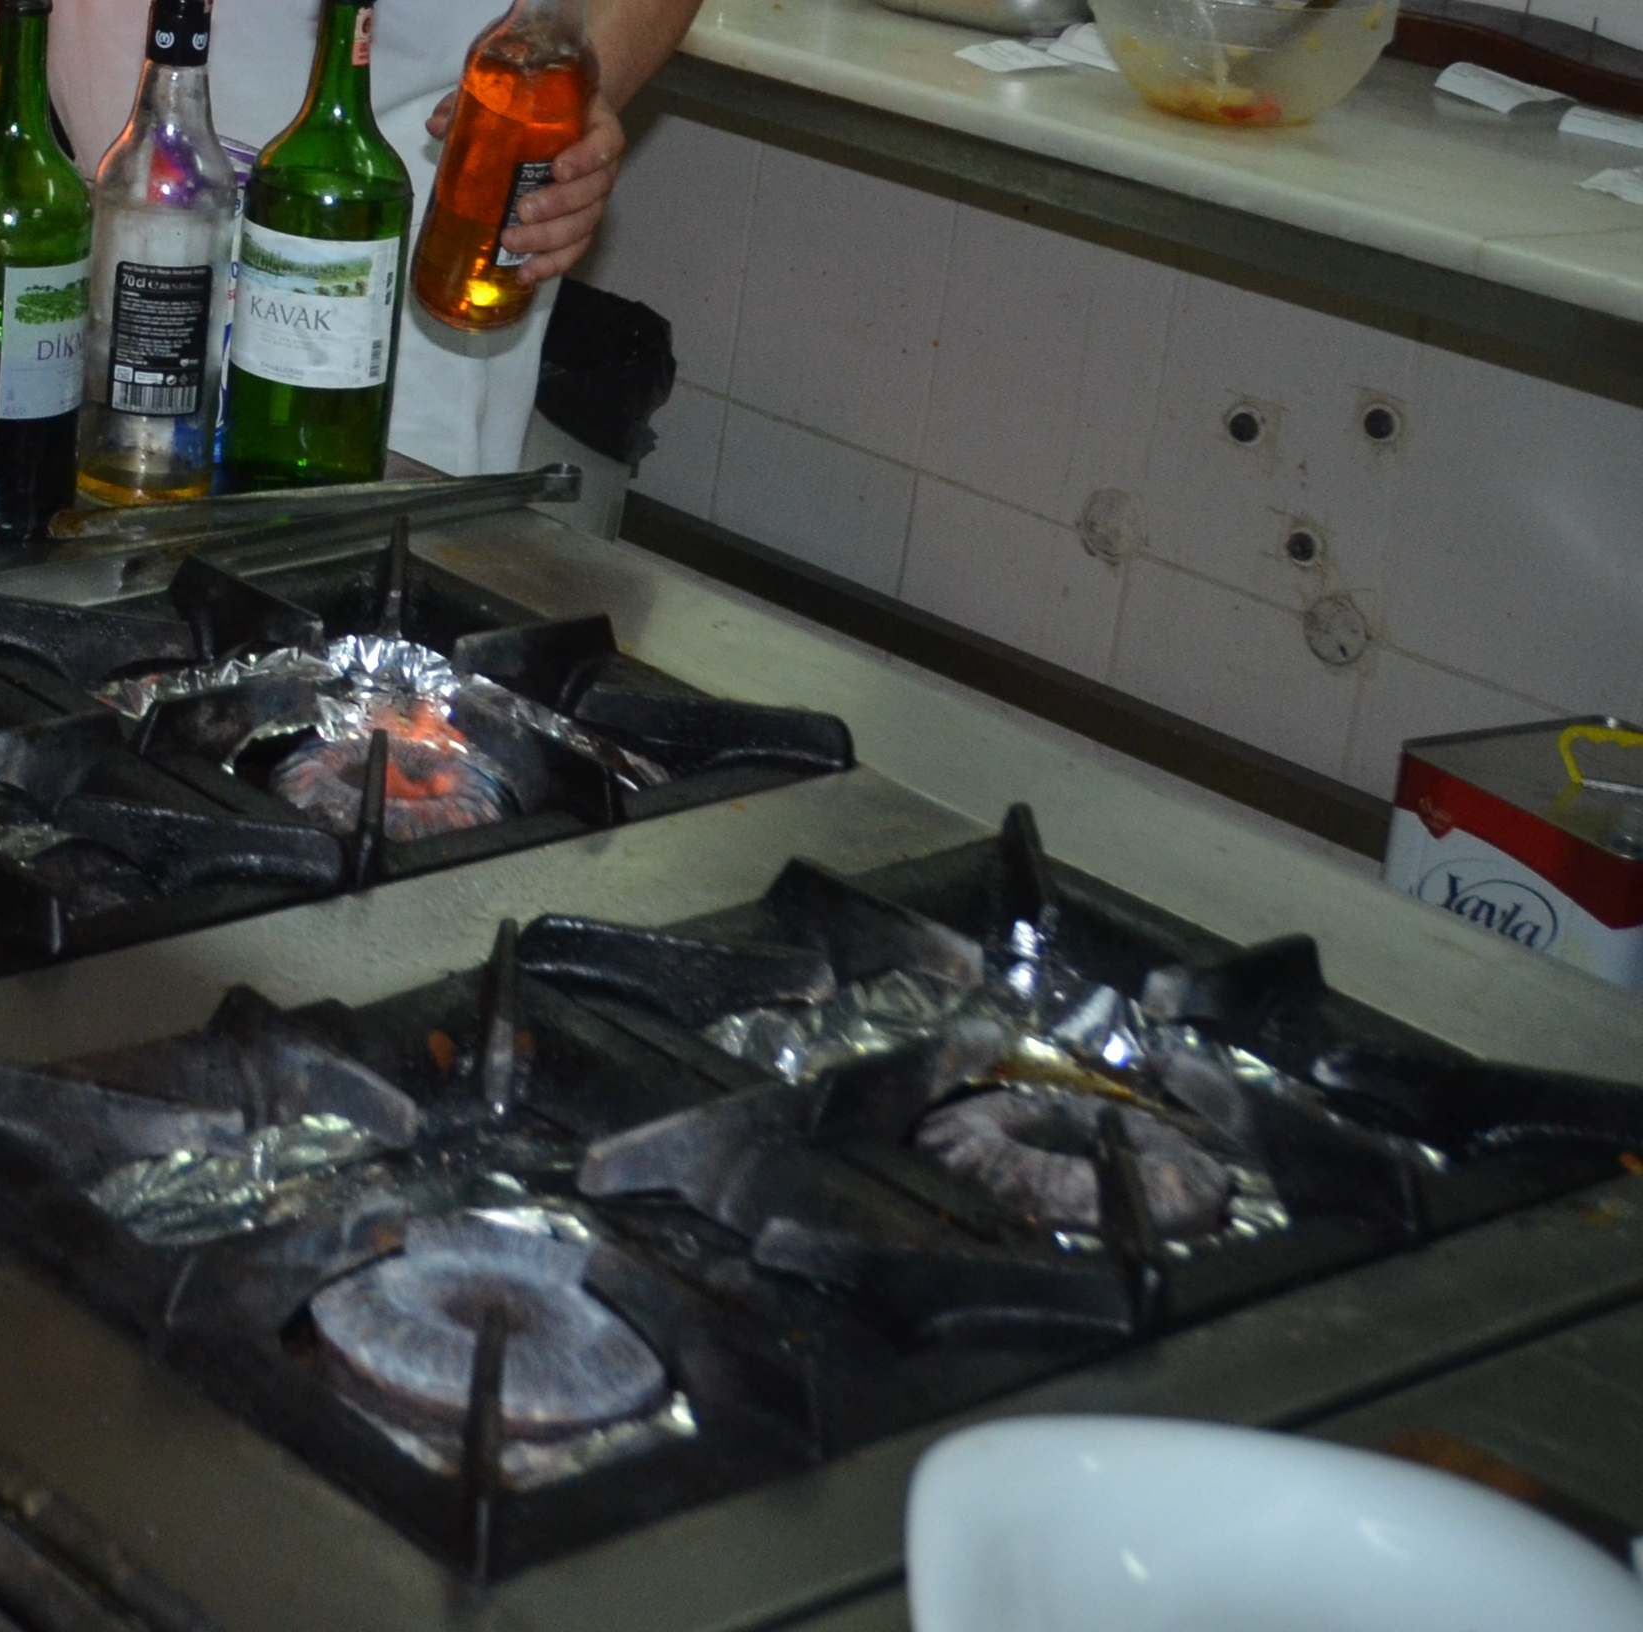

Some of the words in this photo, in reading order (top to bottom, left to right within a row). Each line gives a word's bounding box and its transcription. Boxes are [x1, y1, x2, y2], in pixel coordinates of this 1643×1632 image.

[121, 273, 135, 287] 70
[136, 277, 147, 289] cl
[250, 295, 331, 331] KAVAK
